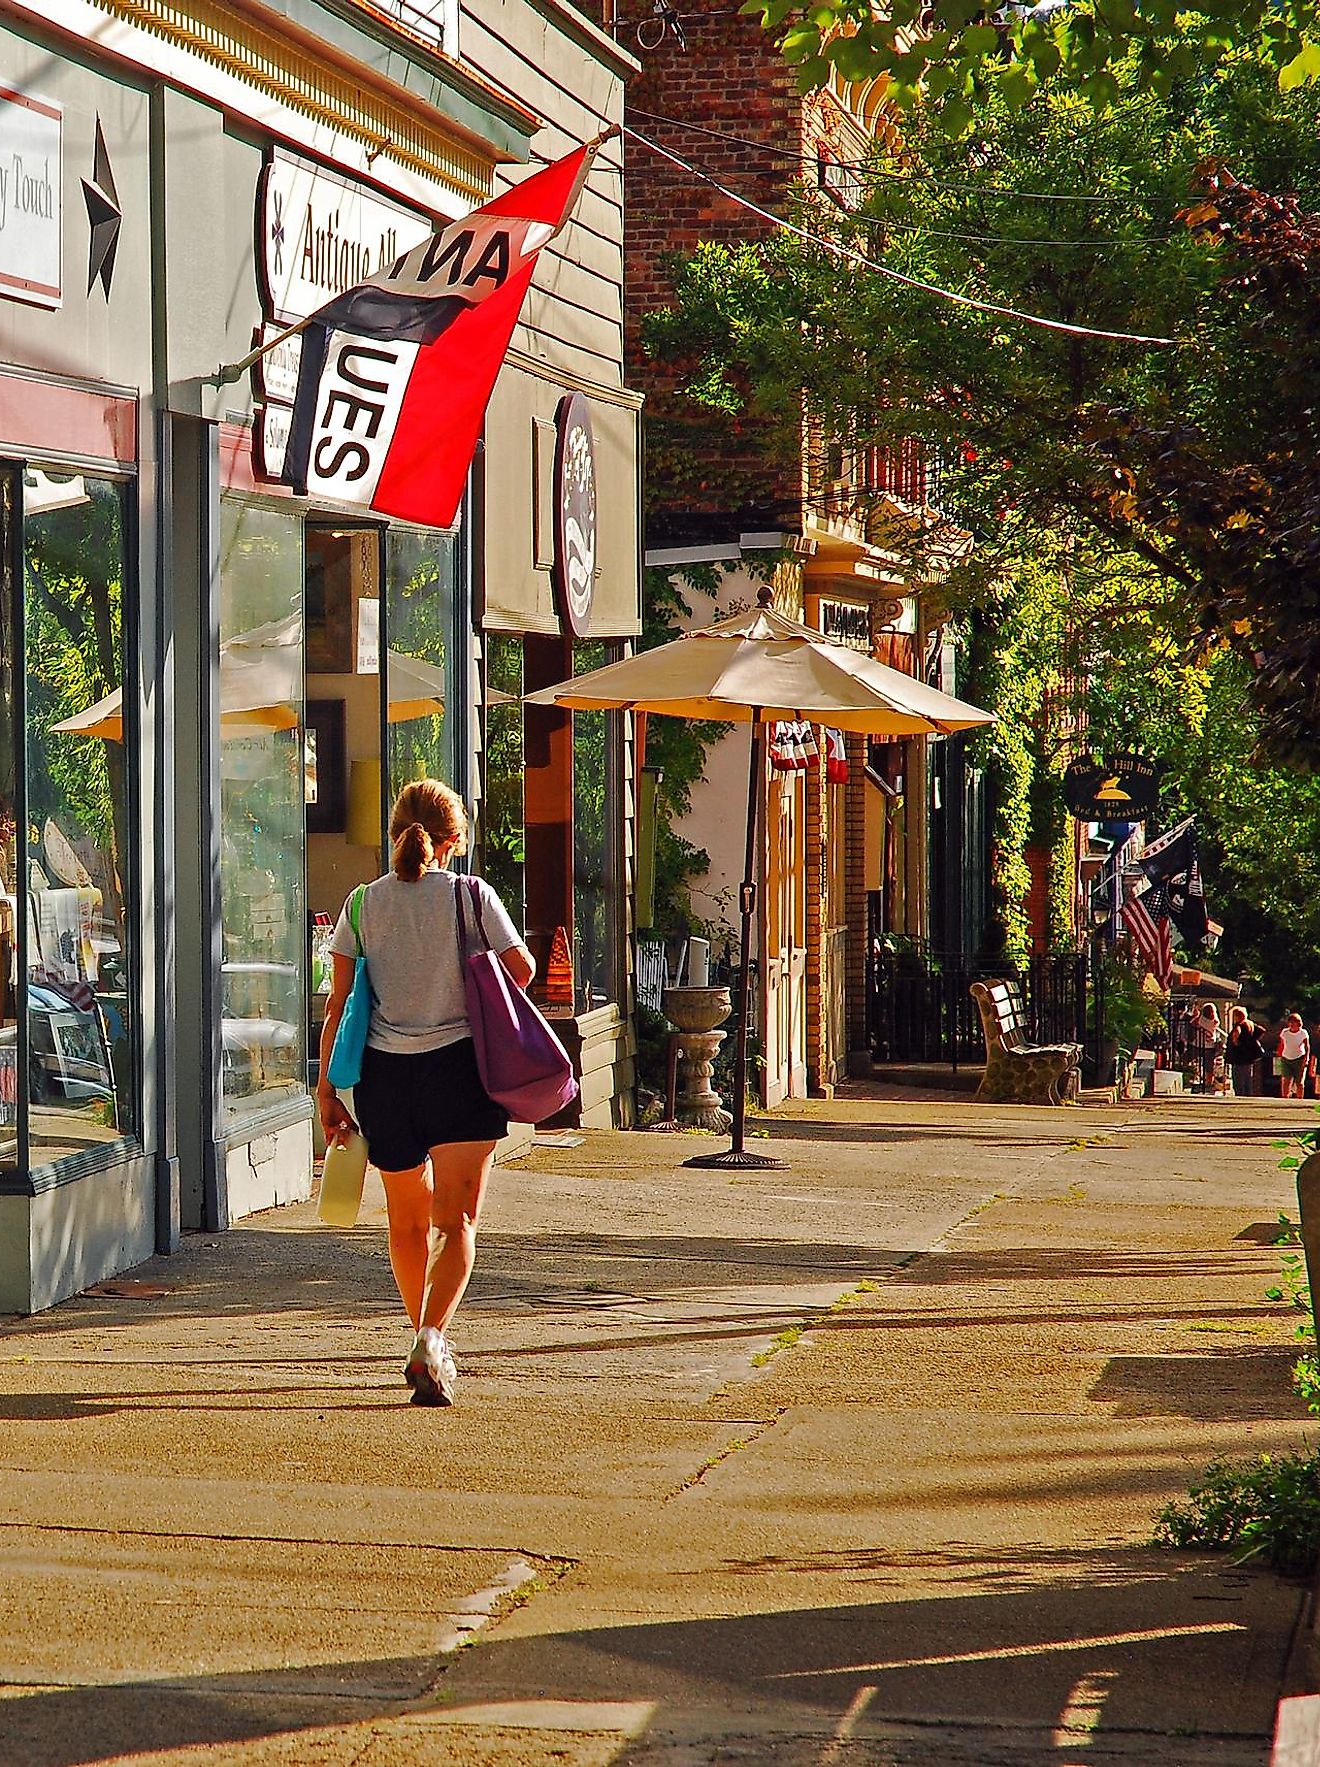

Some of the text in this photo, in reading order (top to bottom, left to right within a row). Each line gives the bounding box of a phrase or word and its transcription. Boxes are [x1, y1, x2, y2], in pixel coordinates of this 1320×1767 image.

[13, 153, 53, 219] Touch
[301, 203, 370, 293] Antique
[1071, 763, 1091, 776] The
[1114, 759, 1134, 771] Hill
[1136, 763, 1154, 777] Inn
[1106, 805, 1149, 818] Breakfast
